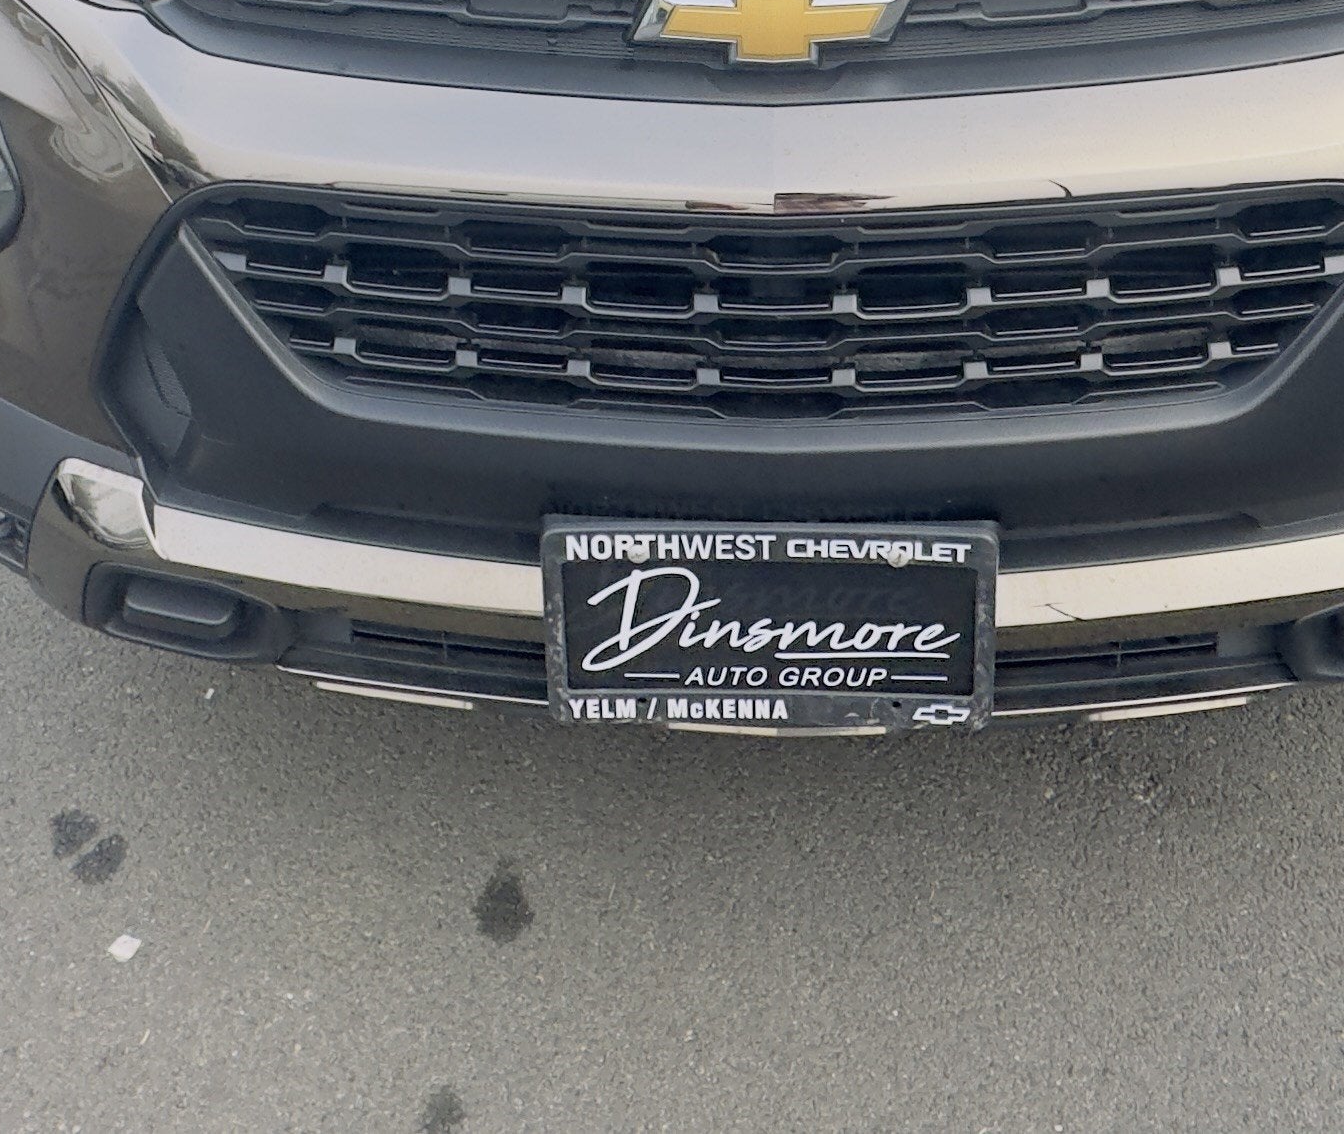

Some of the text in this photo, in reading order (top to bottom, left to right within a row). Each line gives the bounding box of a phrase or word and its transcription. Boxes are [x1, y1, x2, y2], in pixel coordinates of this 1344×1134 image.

[565, 534, 972, 564] NORTHWEST CHEVROLET
[582, 567, 962, 671] Dinsmore
[685, 667, 888, 688] AUTO GROUP
[568, 698, 637, 720] YELM
[667, 699, 789, 721] McKENNA
